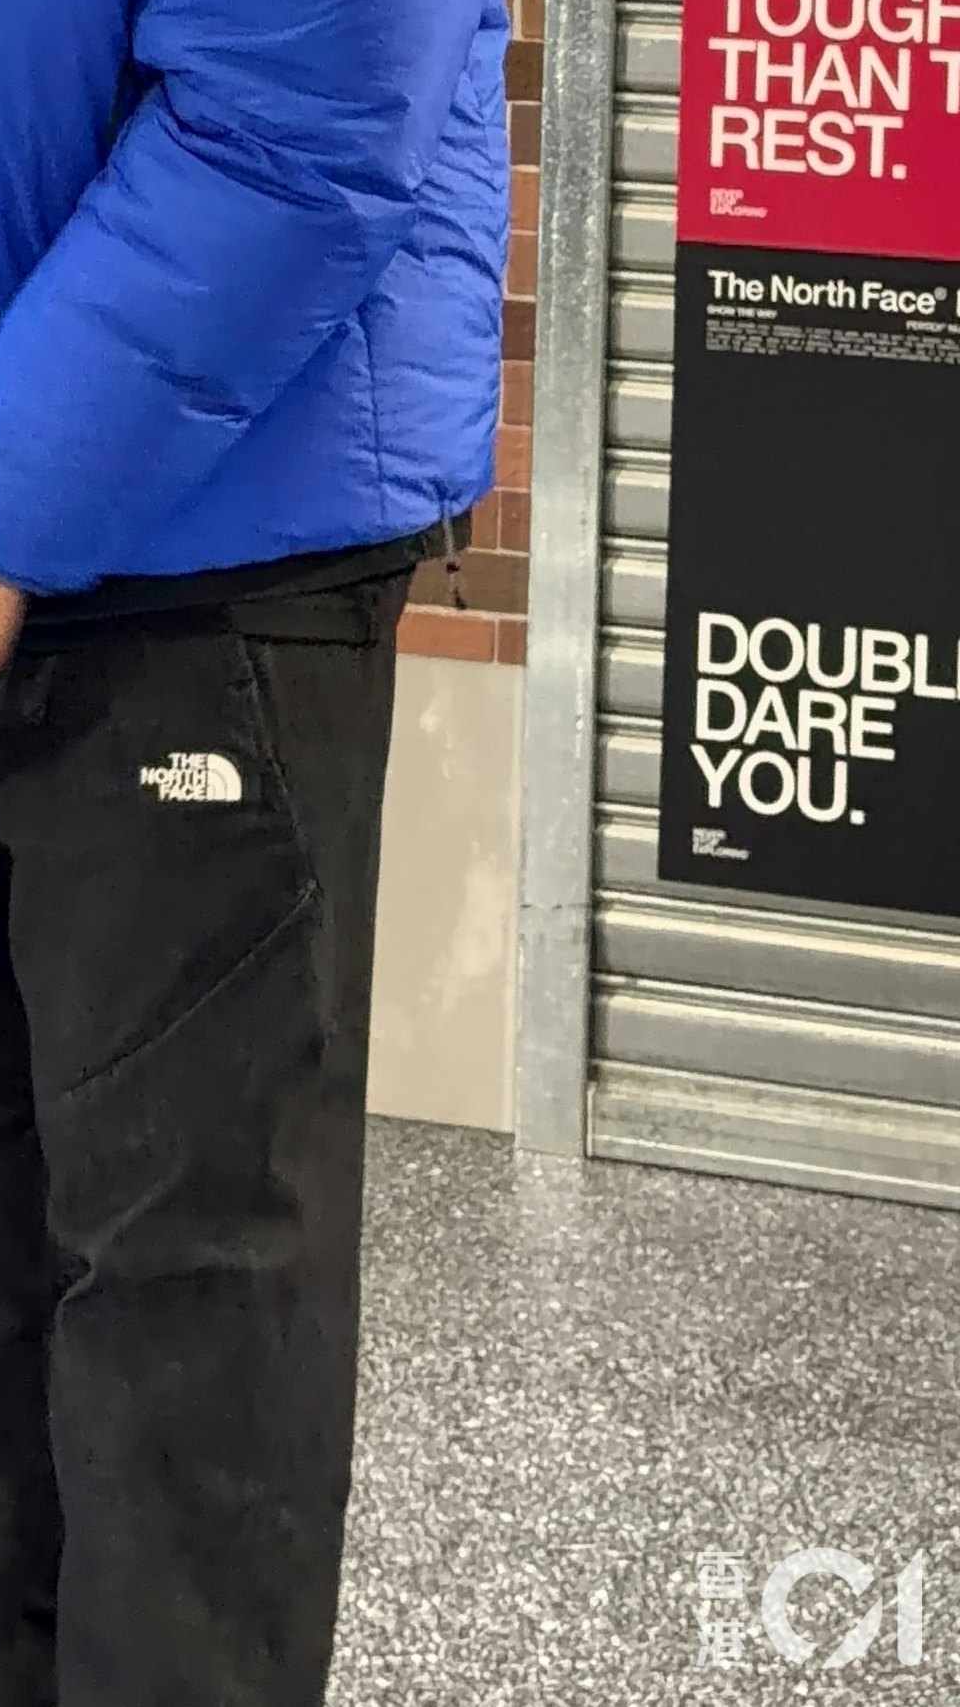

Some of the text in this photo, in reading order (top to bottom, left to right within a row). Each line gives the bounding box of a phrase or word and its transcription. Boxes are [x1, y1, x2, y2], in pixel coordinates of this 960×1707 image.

[707, 37, 911, 112] THAN
[709, 105, 908, 181] REST.
[706, 268, 764, 302] The
[770, 273, 856, 310] North
[698, 612, 960, 700] DOUBL
[695, 678, 896, 761] DARE
[140, 767, 207, 786] NORTH
[159, 783, 208, 802] FACE
[168, 752, 207, 769] THE
[690, 744, 866, 825] YOU.
